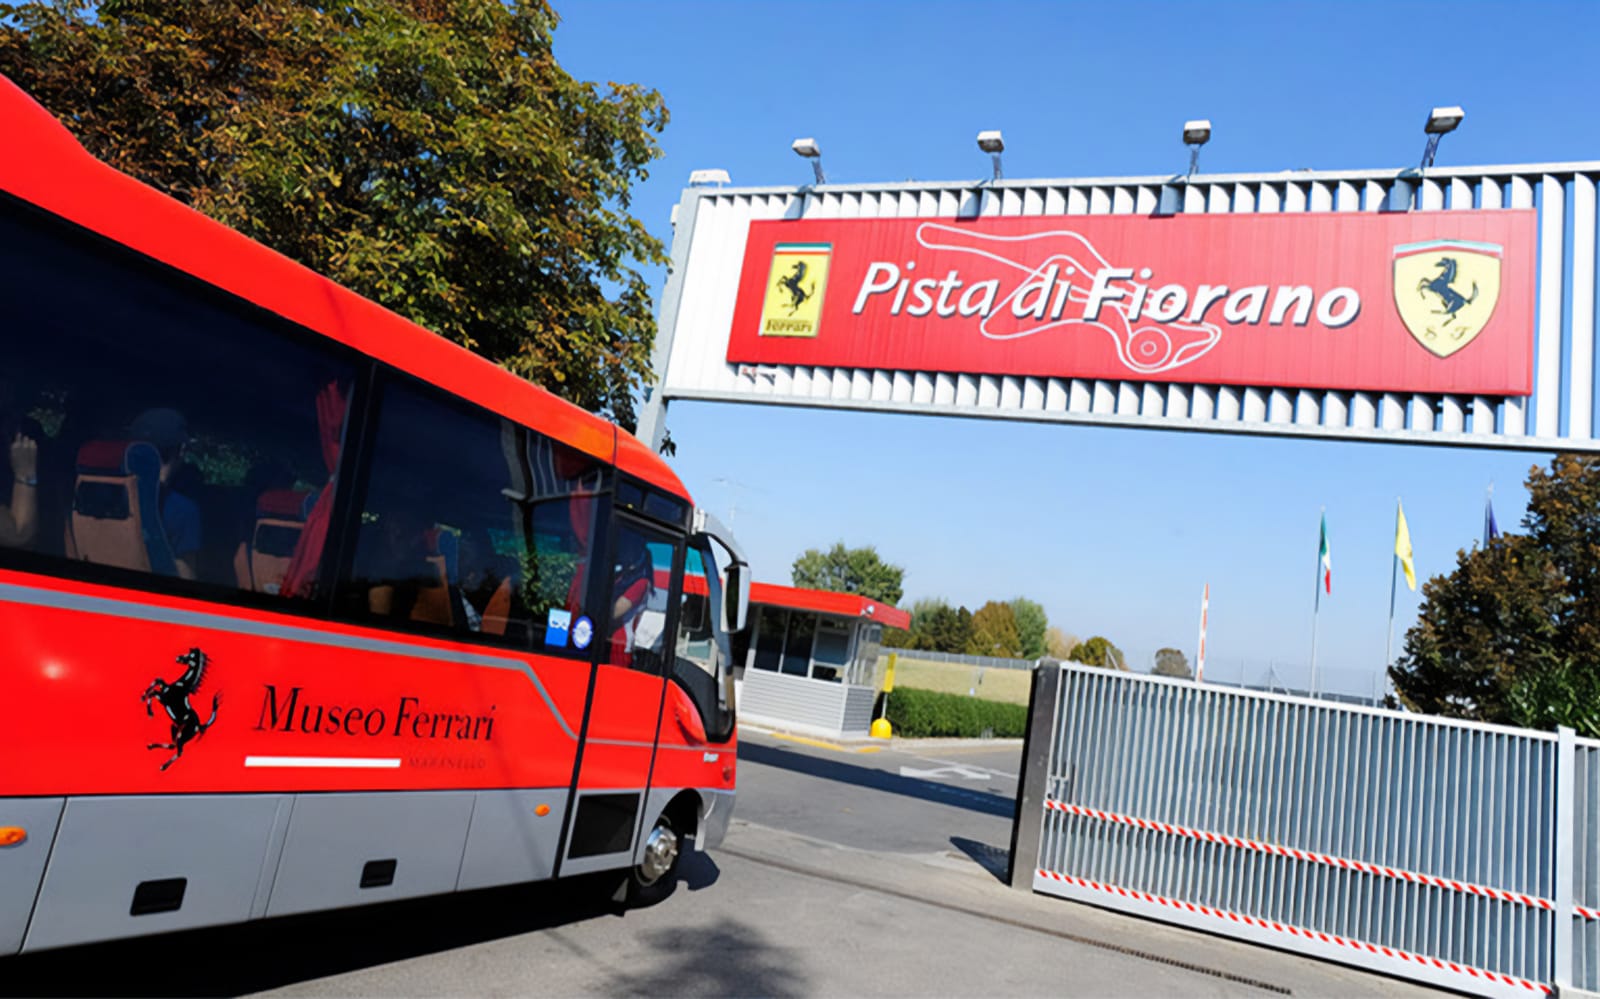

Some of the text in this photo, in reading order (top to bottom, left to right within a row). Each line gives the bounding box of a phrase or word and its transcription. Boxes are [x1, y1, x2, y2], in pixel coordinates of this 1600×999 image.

[852, 261, 1361, 328] Pista di Fiorano
[765, 319, 812, 332] Ferrari
[253, 685, 496, 741] Museo Ferrari
